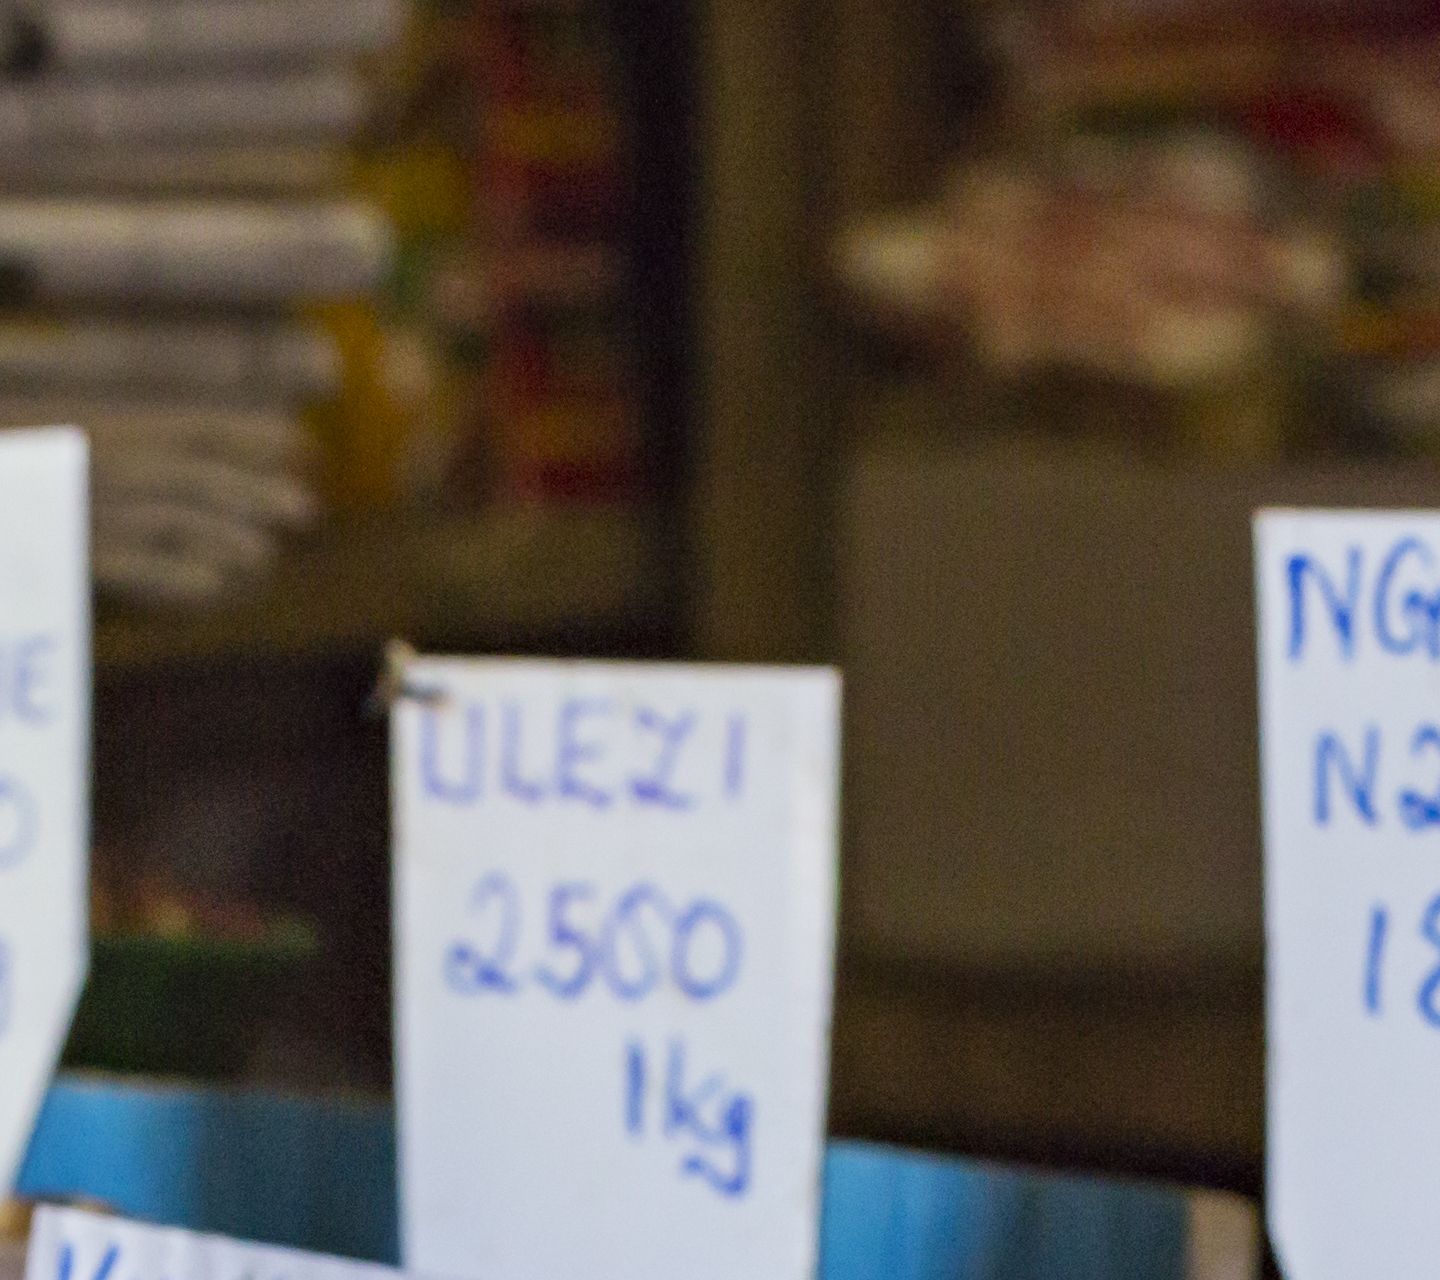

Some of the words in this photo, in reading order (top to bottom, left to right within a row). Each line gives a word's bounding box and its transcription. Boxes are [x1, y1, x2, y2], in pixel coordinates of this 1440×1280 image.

[420, 695, 747, 811] ULEZI
[442, 869, 744, 1005] 2500
[623, 1032, 754, 1199] 1kg
